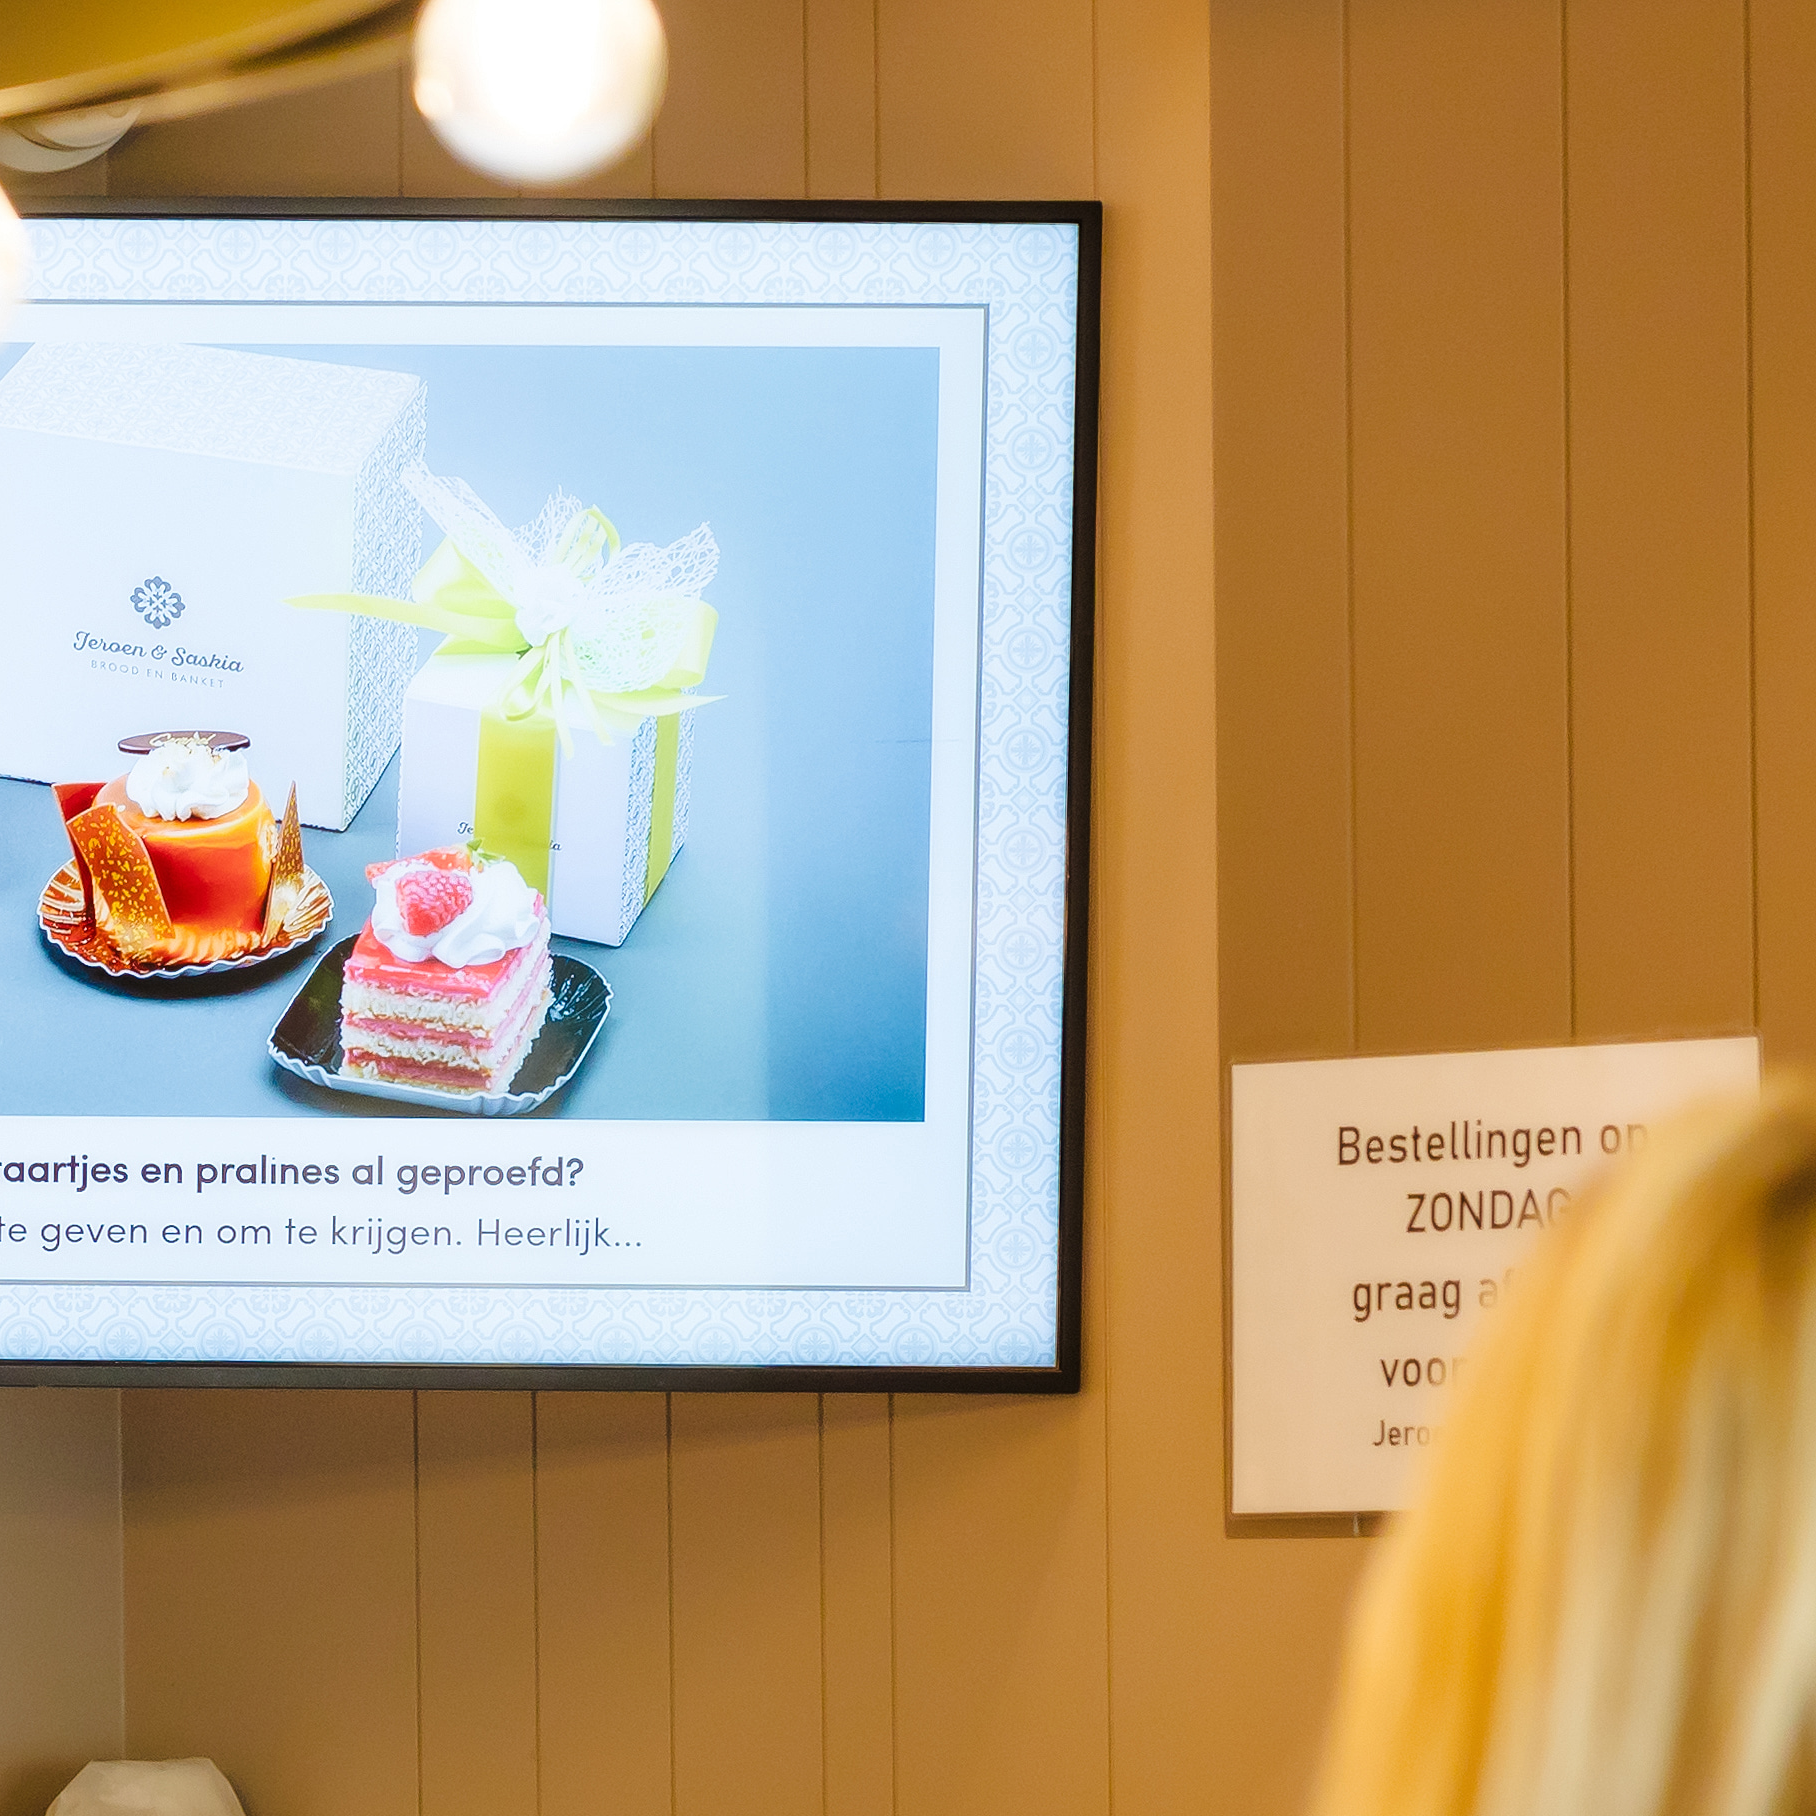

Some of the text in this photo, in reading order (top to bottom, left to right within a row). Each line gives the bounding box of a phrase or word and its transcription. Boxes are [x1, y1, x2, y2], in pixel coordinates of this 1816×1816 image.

[73, 631, 244, 672] Jeroen & Saskia
[91, 659, 224, 688] BROOD EN BANKET
[1337, 1119, 1583, 1168] Bestellingen
[141, 1161, 182, 1183] en
[196, 1154, 340, 1193] pralines
[352, 1156, 383, 1185] al
[396, 1157, 584, 1195] geproefd?
[40, 1223, 148, 1252] geven
[161, 1224, 202, 1244] en
[217, 1224, 271, 1245] om
[285, 1218, 318, 1245] te
[331, 1216, 463, 1254] krijgen.
[478, 1218, 642, 1256] Heerlijk...
[1353, 1278, 1462, 1323] graag
[1372, 1419, 1431, 1446] Jero
